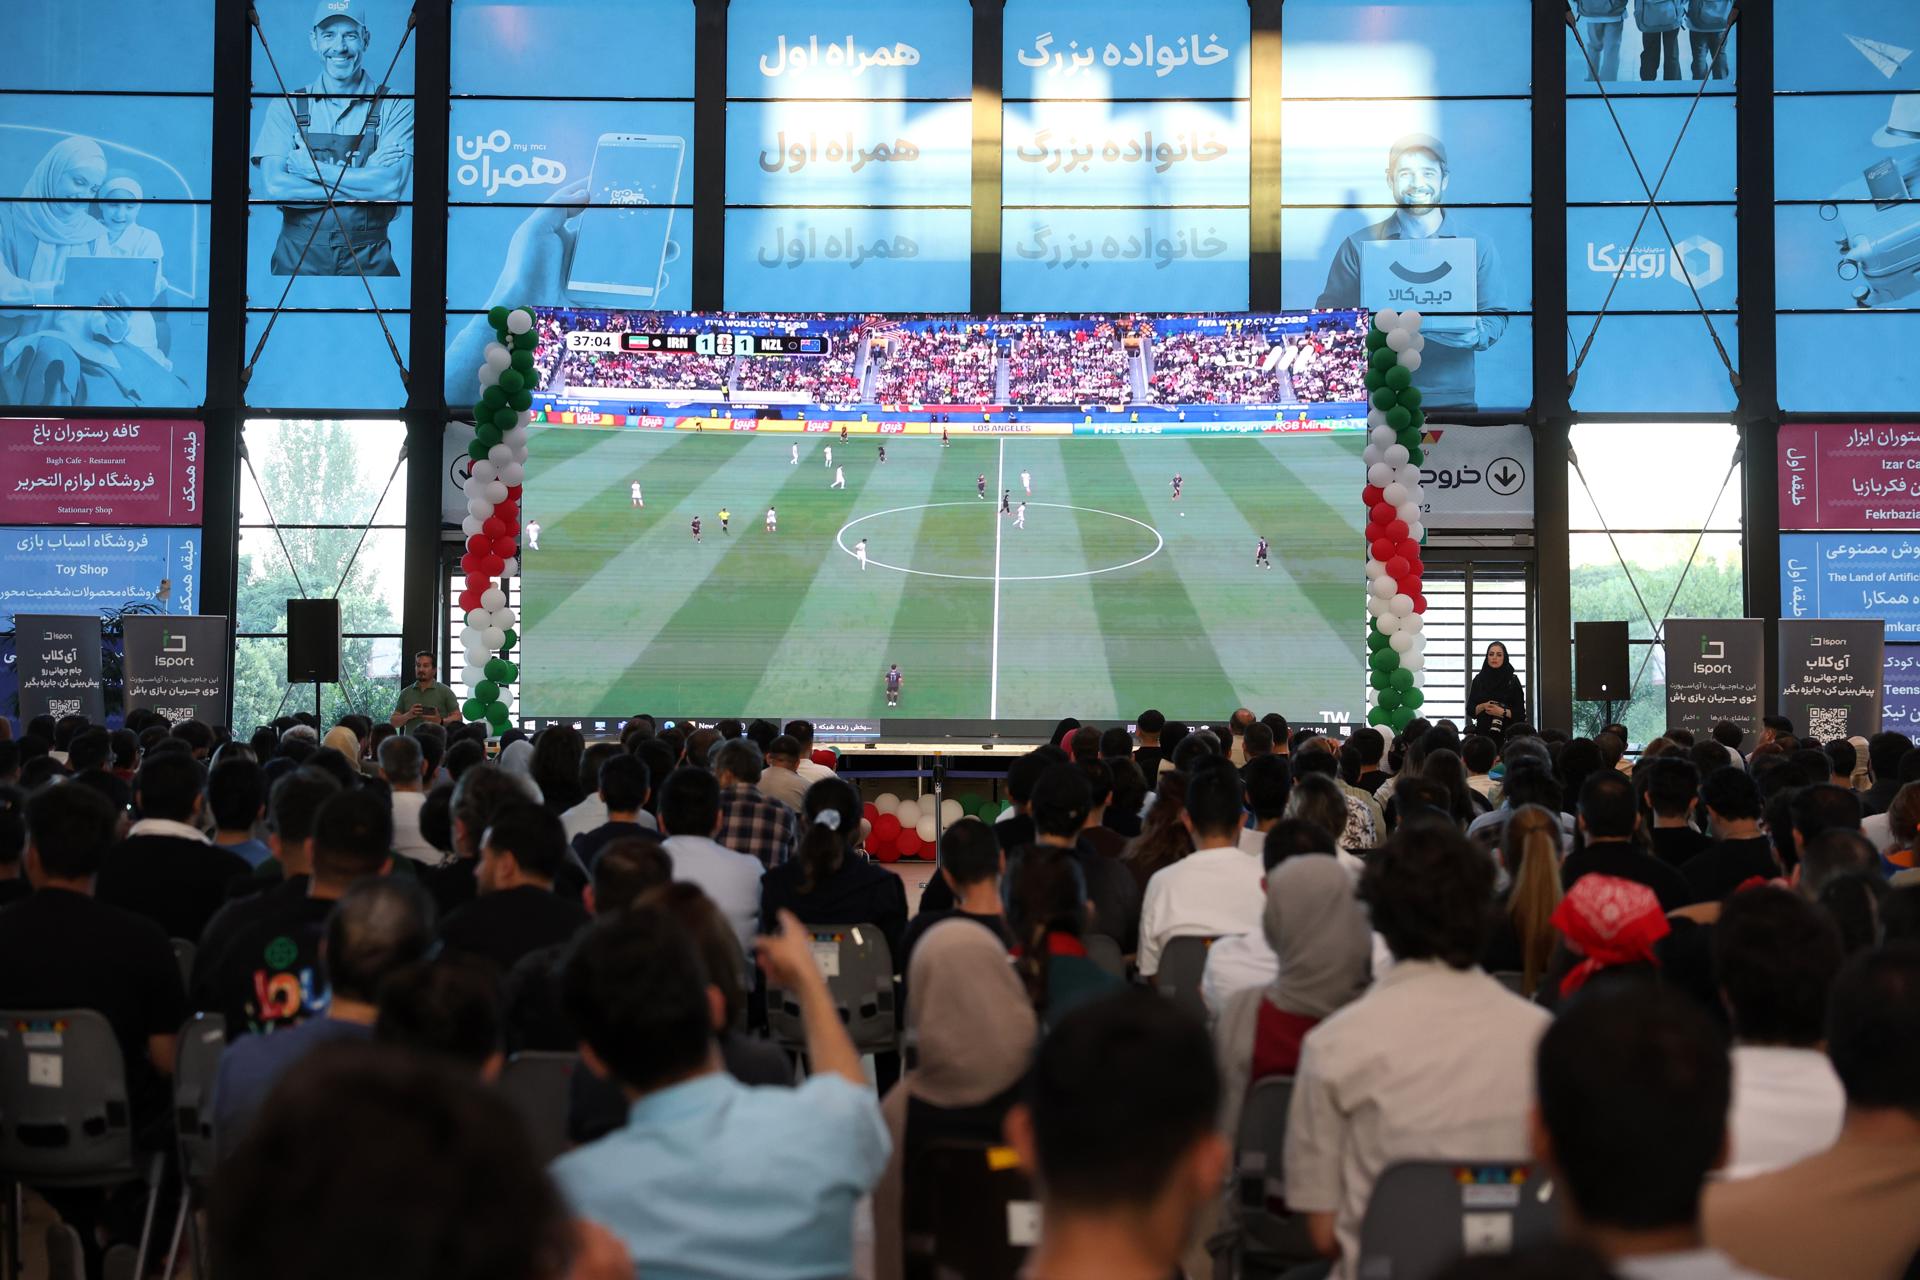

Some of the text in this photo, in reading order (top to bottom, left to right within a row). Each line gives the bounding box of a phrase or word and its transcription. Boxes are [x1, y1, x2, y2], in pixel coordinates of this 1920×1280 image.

[760, 35, 920, 78] همراه اول
[1018, 32, 1228, 78] خانواده بزرگ
[456, 129, 511, 160] من
[759, 131, 920, 173] همراه اول
[1017, 129, 1228, 174] خانواده بزرگ
[457, 155, 566, 197] همراه
[758, 227, 919, 270] همراه اول
[1016, 225, 1228, 270] خانواده بزرگ
[1587, 242, 1665, 278] روبیکا
[1197, 319, 1217, 327] FIFA
[1274, 316, 1308, 325] 2026
[573, 336, 611, 347] 37:04
[667, 337, 688, 349] IRN
[702, 338, 708, 350] 1
[741, 339, 748, 350] 1
[761, 339, 783, 351] NZL
[33, 423, 140, 444] کافه رستوران باغ
[1846, 428, 1874, 447] ایزار
[46, 457, 63, 466] Bagh
[1882, 459, 1904, 469] Izar
[182, 431, 200, 512] طبقه همکف
[1418, 465, 1482, 489] خروج
[1786, 448, 1807, 506] طبقه اول
[14, 472, 155, 492] فروشگاه لوازم التحریر
[1852, 477, 1906, 496] فکربازیا
[58, 506, 113, 515] Stationary Shop
[1424, 504, 1431, 513] 2
[17, 534, 148, 552] فروشگاه اسباب بازی
[180, 539, 197, 571] طبقه
[1826, 543, 1888, 559] مصنوعی
[56, 564, 108, 576] Toy Shop
[1828, 572, 1920, 582] The Land of Artific
[0, 585, 160, 600] فروشگاه محصولات شخصیت محور
[1787, 559, 1808, 616] طبقه اول
[1863, 590, 1909, 609] همکارا
[1884, 622, 1920, 632] mkara
[155, 656, 194, 668] isport
[49, 667, 68, 676] جهانی
[69, 667, 82, 676] جام
[1694, 662, 1732, 675] isport
[24, 677, 40, 688] بگیر
[40, 679, 56, 688] جایزه
[1813, 674, 1837, 683] جهانی
[1839, 674, 1854, 683] جام
[129, 686, 147, 696] باش
[149, 686, 167, 696] بازی
[202, 688, 218, 696] توی
[1783, 684, 1800, 695] بگیر
[1801, 686, 1821, 695] جایزه
[1884, 685, 1920, 695] Teens
[1670, 692, 1686, 702] باش
[1688, 693, 1705, 703] بازی
[1739, 695, 1757, 704] توی
